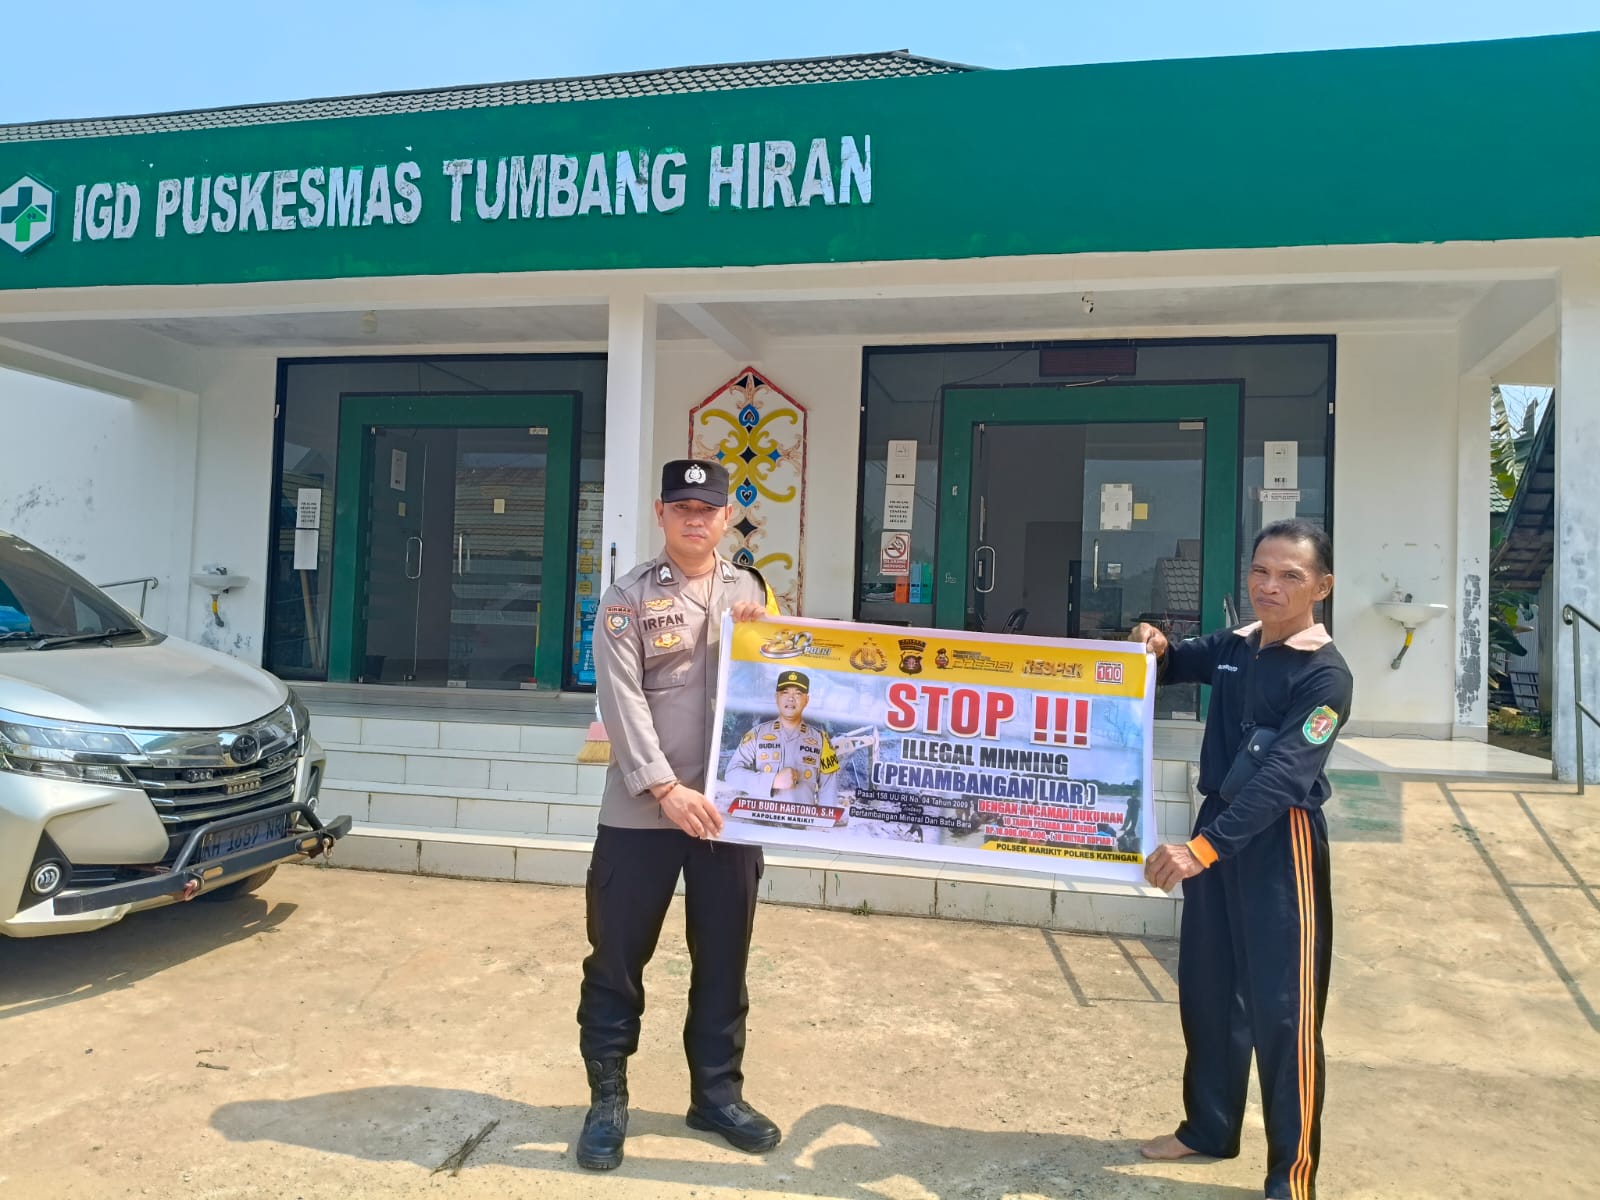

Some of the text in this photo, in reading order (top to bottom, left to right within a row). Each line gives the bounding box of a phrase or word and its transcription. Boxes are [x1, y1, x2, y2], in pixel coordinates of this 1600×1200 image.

[72, 134, 871, 243] IGD PUSKESMAS TUMBANG HIRAN
[643, 613, 684, 631] IRFAN
[1097, 665, 1120, 680] 110
[886, 682, 1090, 746] STOP !!!
[902, 738, 1070, 776] ILLEGAL MINNING
[738, 799, 757, 809] IPTU
[758, 801, 778, 812] BUDI
[779, 804, 819, 816] HARTONO,
[857, 789, 875, 799] Pasal
[889, 793, 900, 801] UU
[901, 794, 908, 802] RI
[932, 798, 952, 807] Tahun
[953, 800, 968, 809] 2009
[751, 812, 815, 824] KAPOLSEK MARIKIT
[850, 807, 972, 829] Pertambangan Mineral Dan Batu Bara
[978, 801, 1124, 824] DENGAN ANCAMAN HUKUMAN
[996, 842, 1138, 863] POLSEK MARIKIT POLRES KATINGAN
